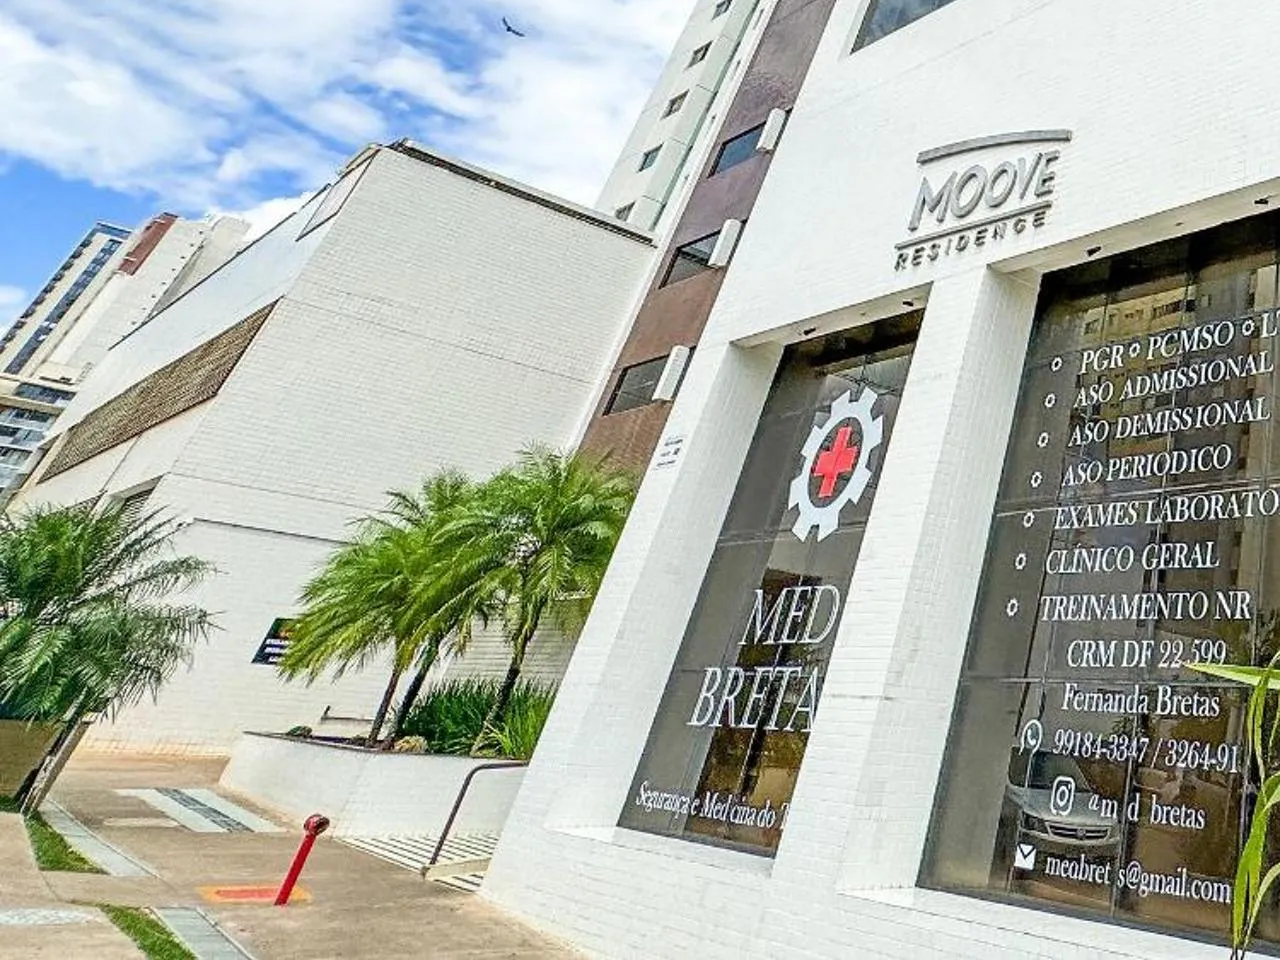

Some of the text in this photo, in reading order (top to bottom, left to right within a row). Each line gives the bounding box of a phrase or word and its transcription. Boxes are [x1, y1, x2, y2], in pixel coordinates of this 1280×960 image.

[907, 150, 1060, 232] MOOVE
[894, 210, 1046, 272] RESIDENCE
[1079, 342, 1124, 375] PGR
[1146, 321, 1234, 360] PCMSO
[1073, 350, 1274, 408] ASO ADMISSIONAL
[1068, 396, 1271, 448] ASO DEMISSIONAL
[1061, 444, 1232, 487] ASO PERIODICO
[1054, 501, 1138, 530] EXAMES
[1046, 541, 1220, 575] CLÍNICO GERAL
[738, 584, 841, 646] MED
[1040, 590, 1252, 622] TREINAMENTO NR
[1067, 639, 1116, 668] CRM
[1121, 639, 1154, 668] DF
[686, 666, 819, 732] BRETA
[1061, 683, 1220, 717] Fernanda Bretas
[1053, 729, 1149, 763] 99184-3347
[757, 799, 776, 828] do
